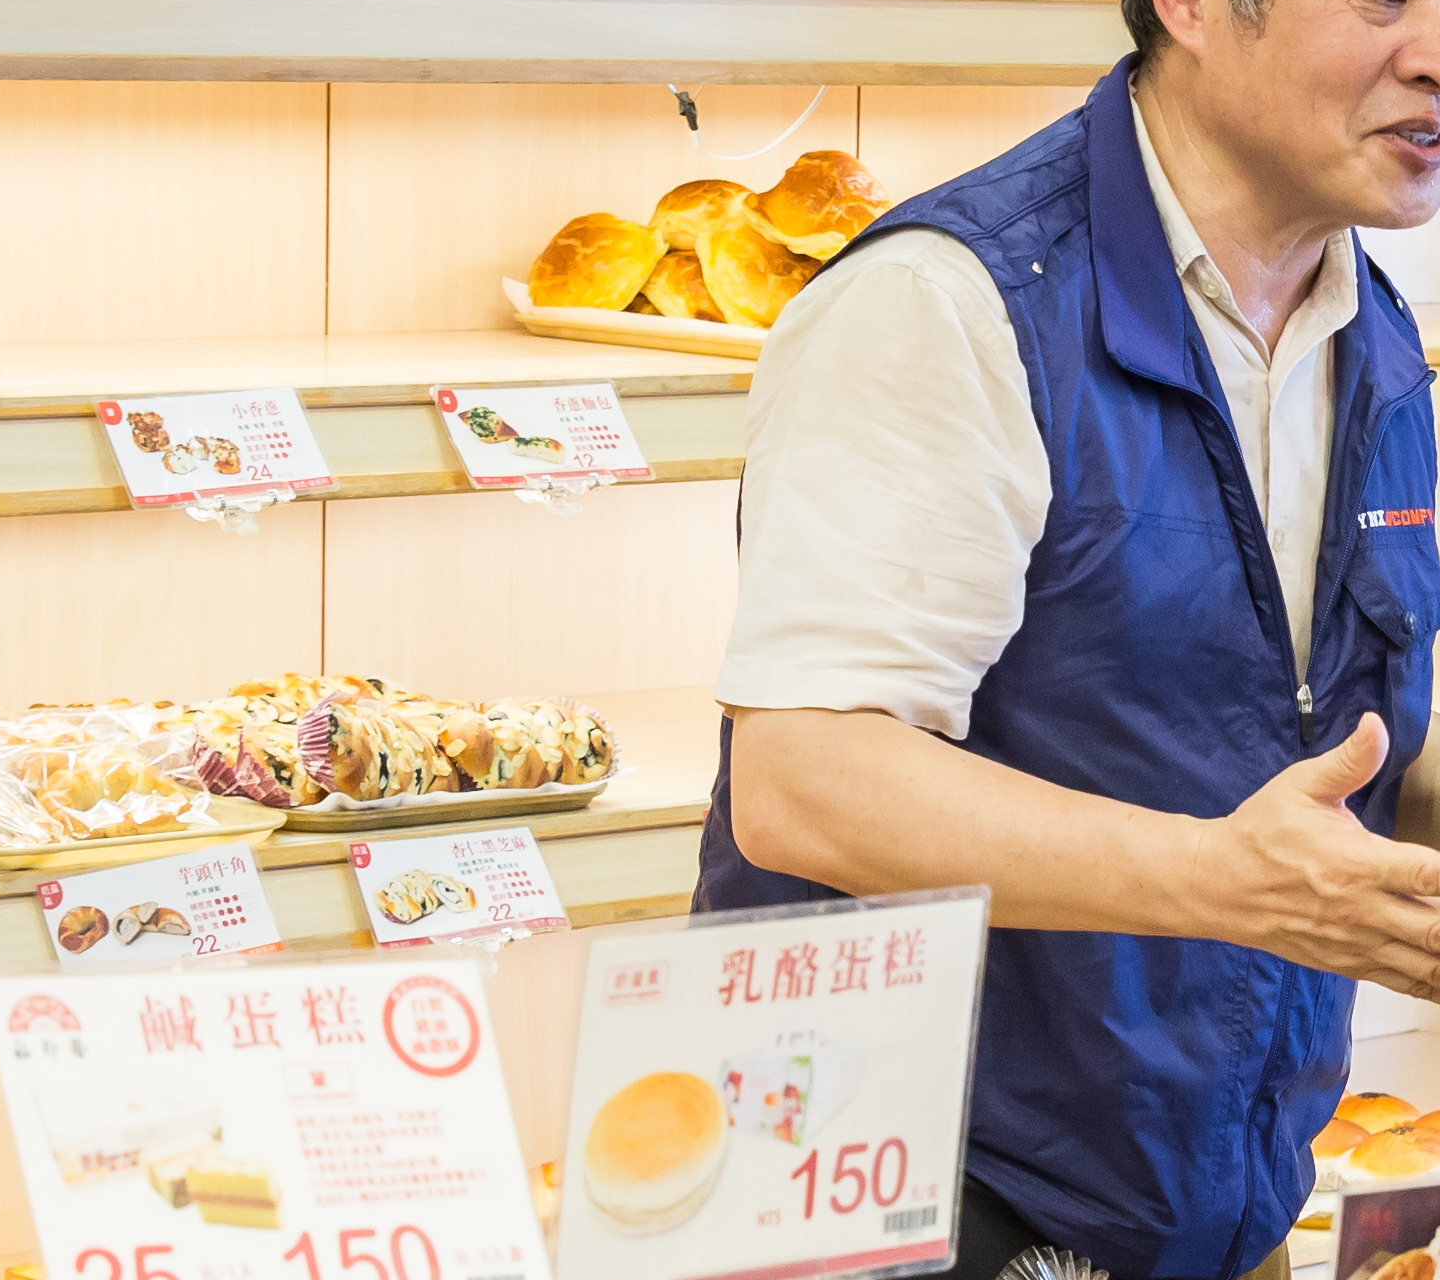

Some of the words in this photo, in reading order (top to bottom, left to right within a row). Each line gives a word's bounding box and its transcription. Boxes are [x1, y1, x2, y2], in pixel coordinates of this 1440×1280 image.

[231, 399, 282, 420] 小香蔥
[552, 394, 613, 413] 香蔥麵包
[573, 453, 596, 468] 12
[246, 464, 273, 481] 24
[451, 835, 528, 859] 杏仁黑芝麻
[176, 856, 247, 886] 芋頭牛角
[487, 903, 515, 922] 22
[192, 934, 221, 956] 22
[717, 928, 929, 1008] 乳酪蛋糕
[138, 984, 368, 1056] 鹹蛋糕
[790, 1135, 910, 1221] 150
